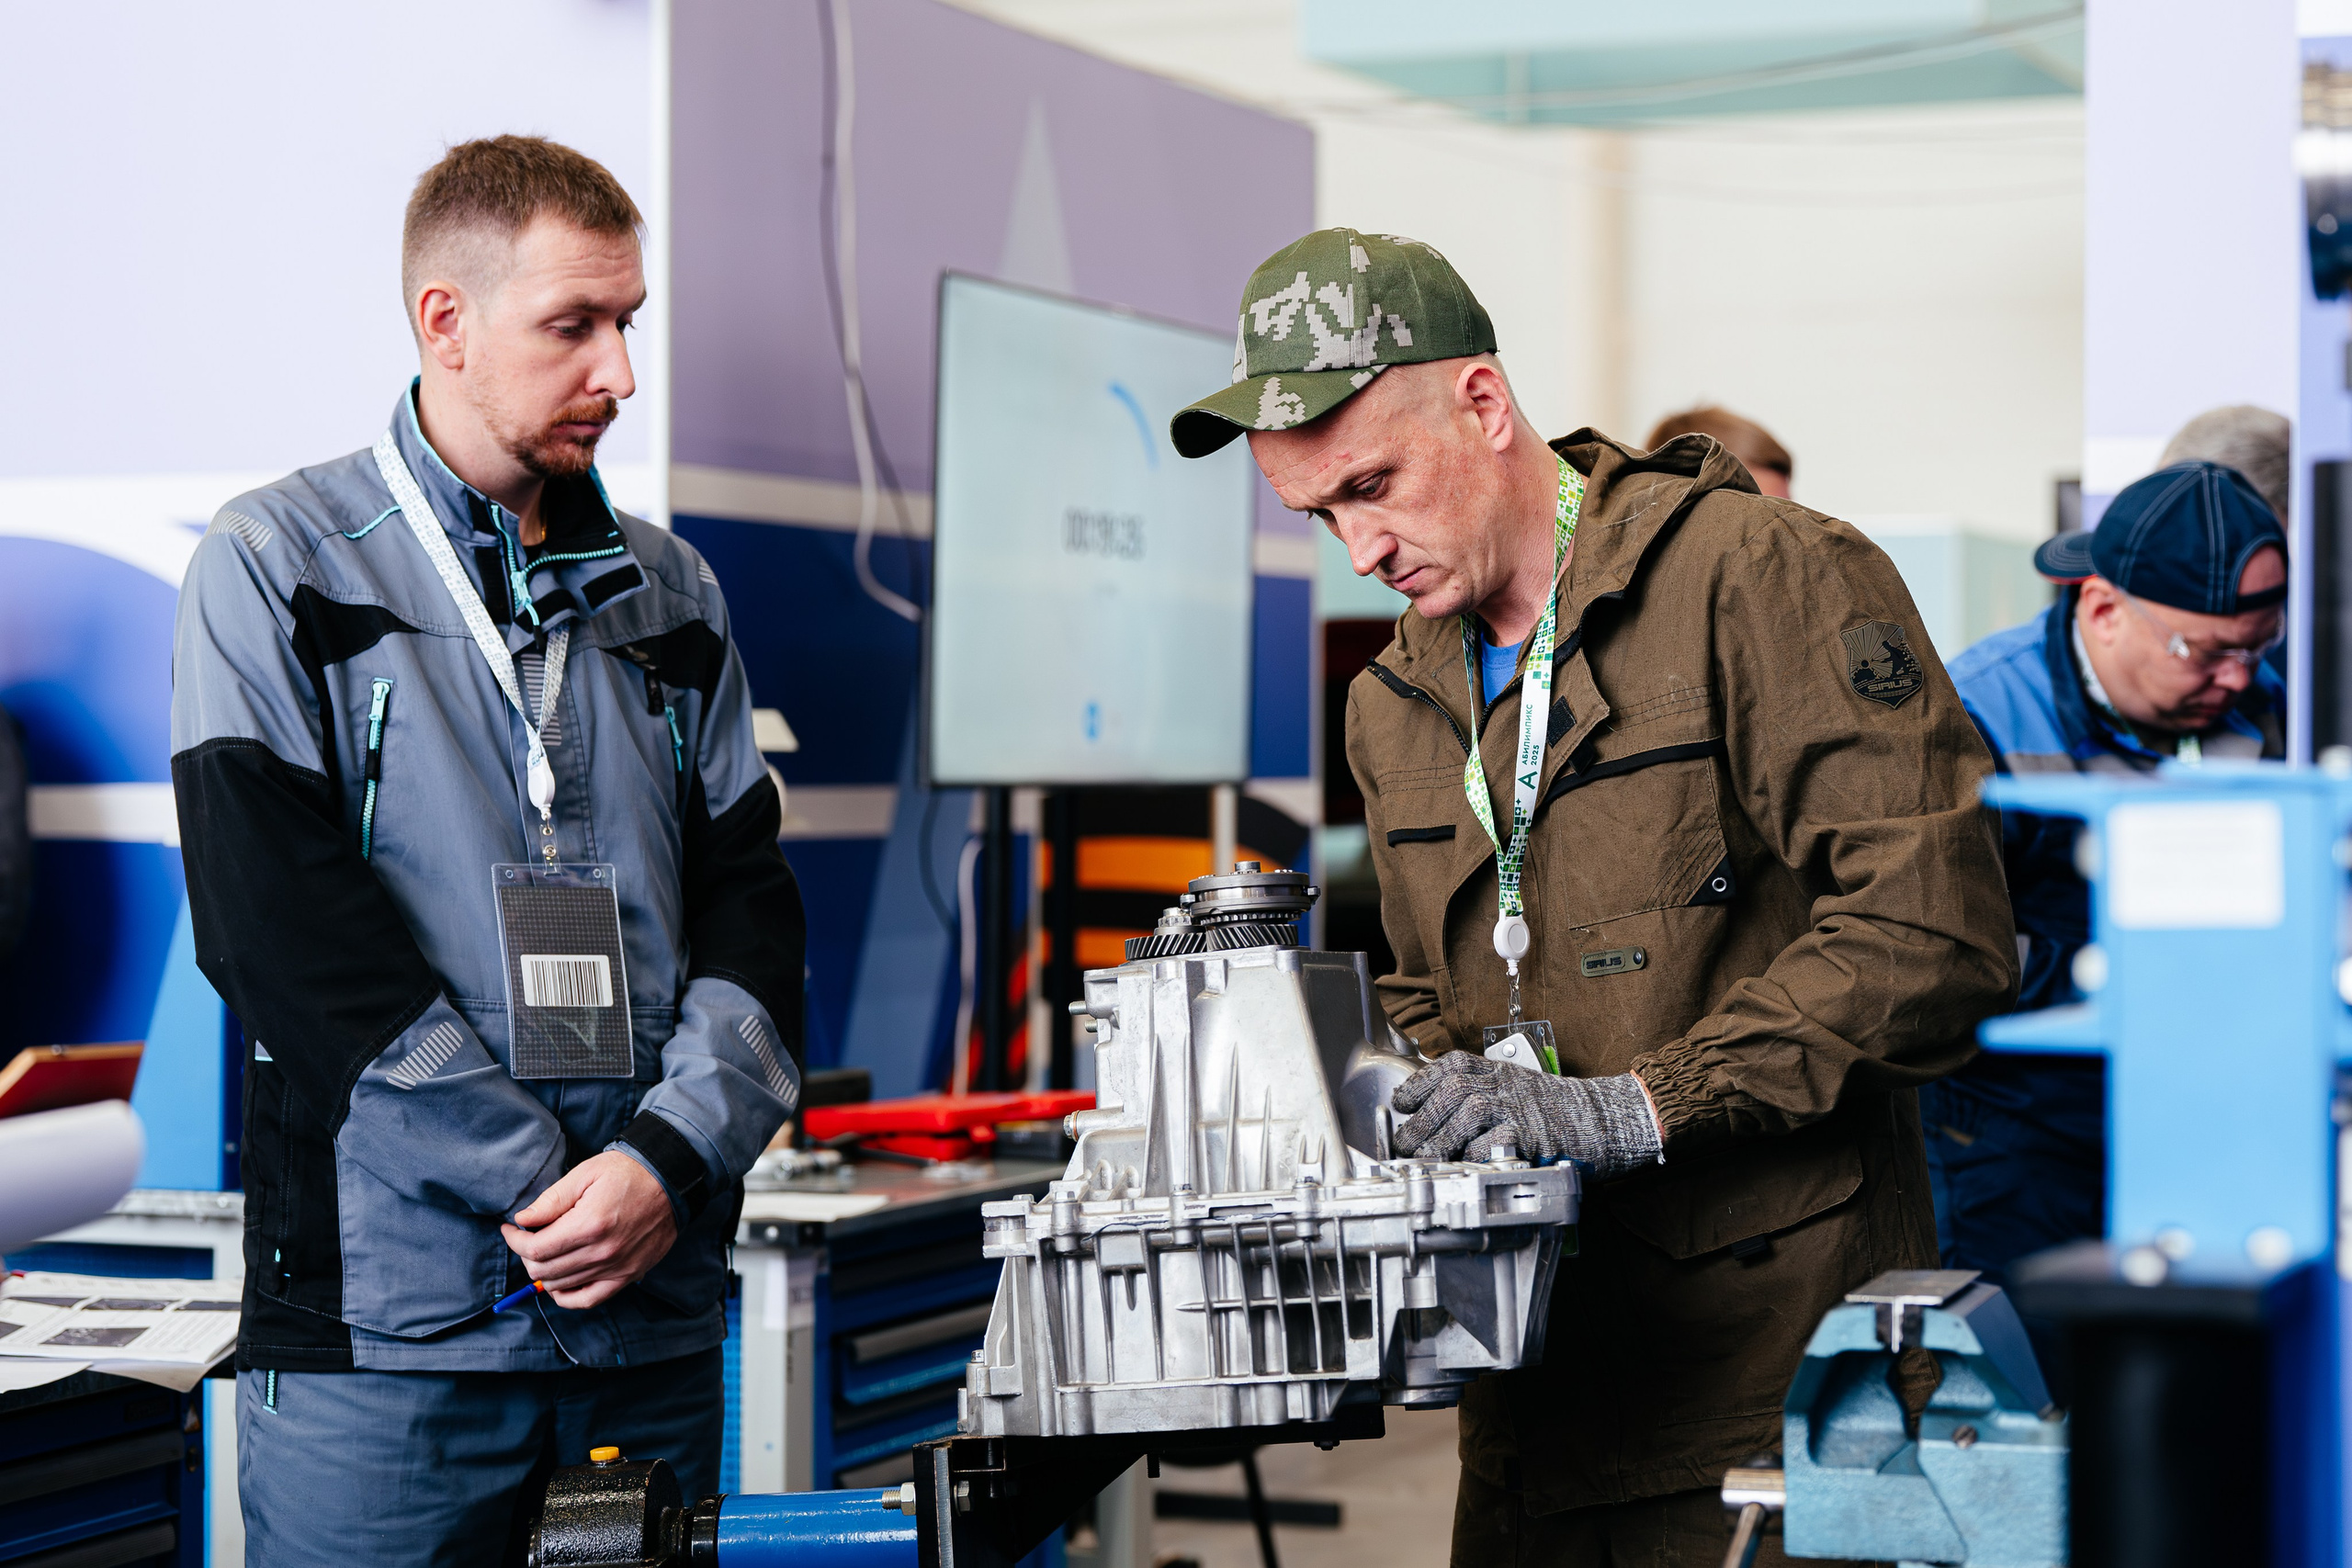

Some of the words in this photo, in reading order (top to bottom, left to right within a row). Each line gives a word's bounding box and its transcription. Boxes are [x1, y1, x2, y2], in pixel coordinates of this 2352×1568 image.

[1868, 679, 1912, 693] SIRIUS
[1521, 704, 1533, 766] АБИЛИМПИКС
[1531, 745, 1540, 766] 2025
[1587, 955, 1622, 969] SIRIUS
